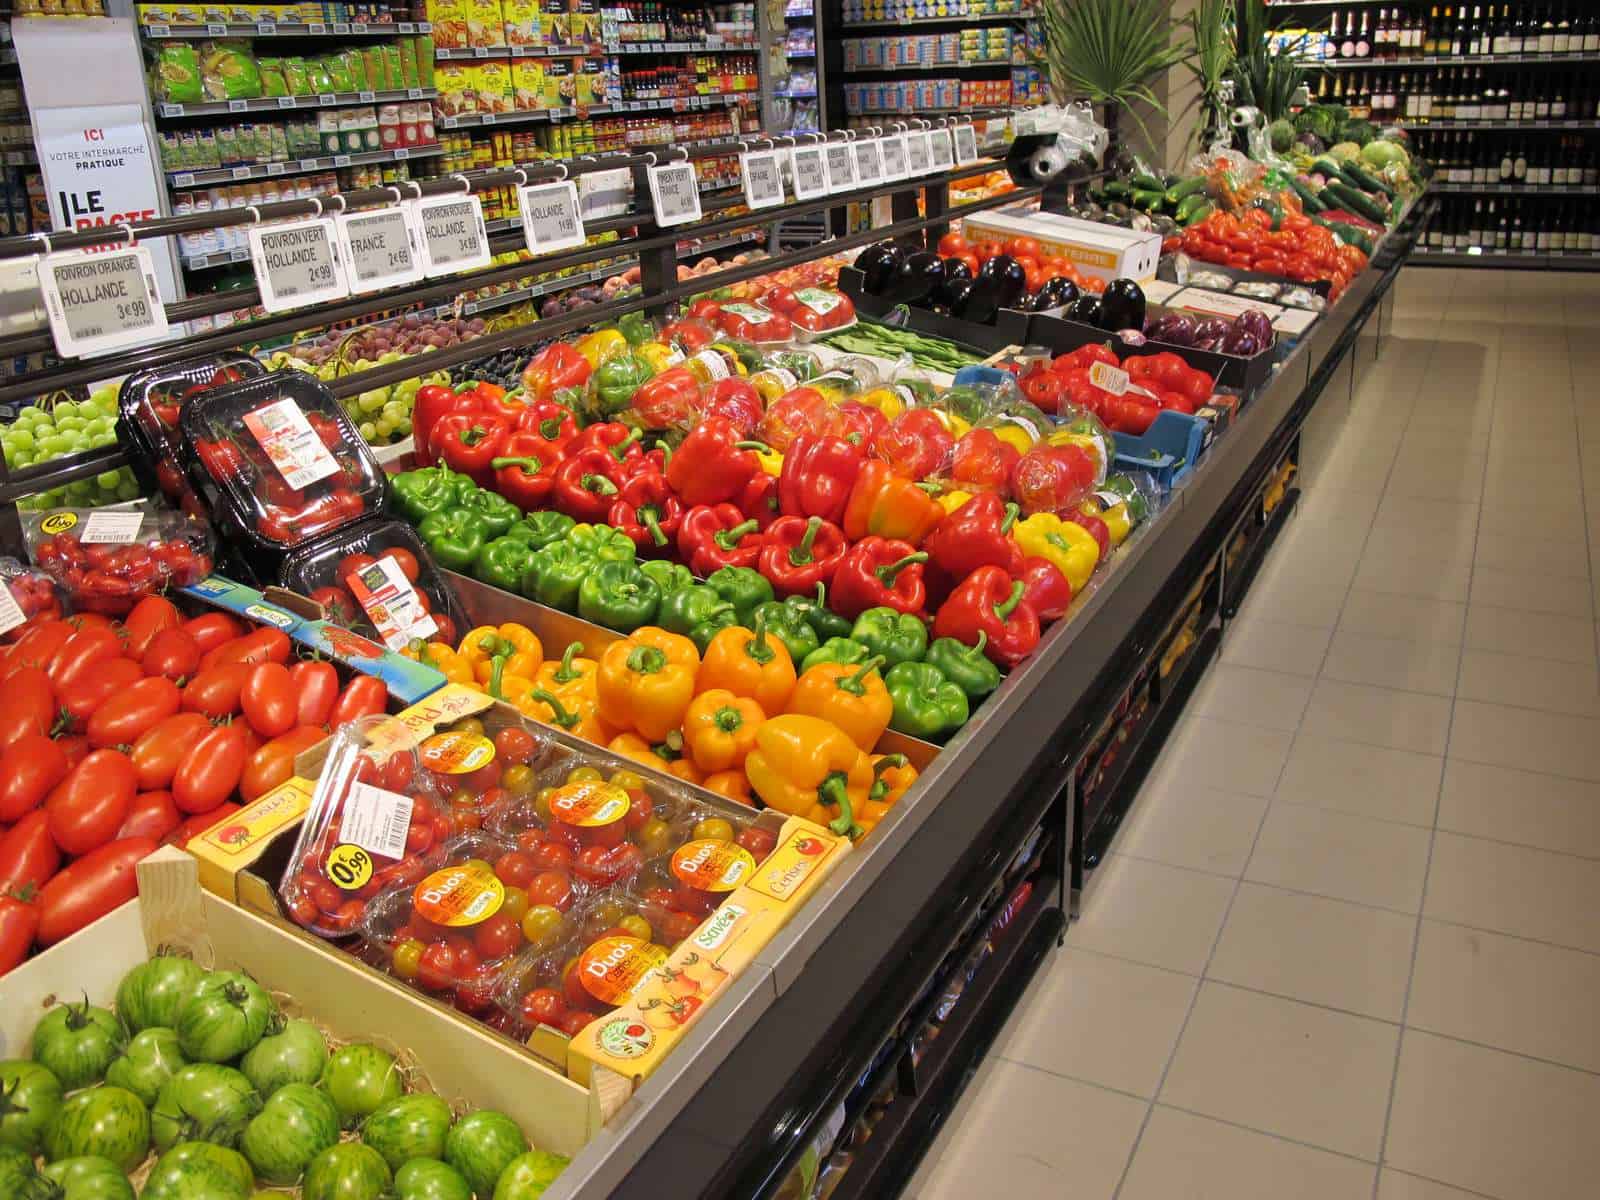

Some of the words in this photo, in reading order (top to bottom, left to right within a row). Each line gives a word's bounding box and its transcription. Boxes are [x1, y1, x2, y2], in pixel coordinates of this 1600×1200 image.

[83, 128, 105, 142] ICI
[50, 151, 81, 161] VOTRE
[82, 144, 145, 159] INTERMARCHÉ
[76, 158, 126, 171] PRATIQUE
[70, 190, 105, 215] LE
[529, 202, 566, 221] HOLLANDE
[261, 231, 302, 251] POIVRON
[302, 228, 326, 244] VERT
[425, 220, 467, 241] HOLLANDE
[350, 234, 386, 256] FRANCE
[54, 265, 98, 282] POIVRON
[98, 257, 138, 274] ORANGE
[264, 247, 318, 271] HOLLANDE
[309, 264, 332, 283] 2€99
[60, 280, 129, 309] HOLLANDE
[116, 300, 147, 320] 3€99
[679, 843, 718, 873] Duos
[421, 871, 466, 904] Duos
[585, 942, 634, 978] Duos
